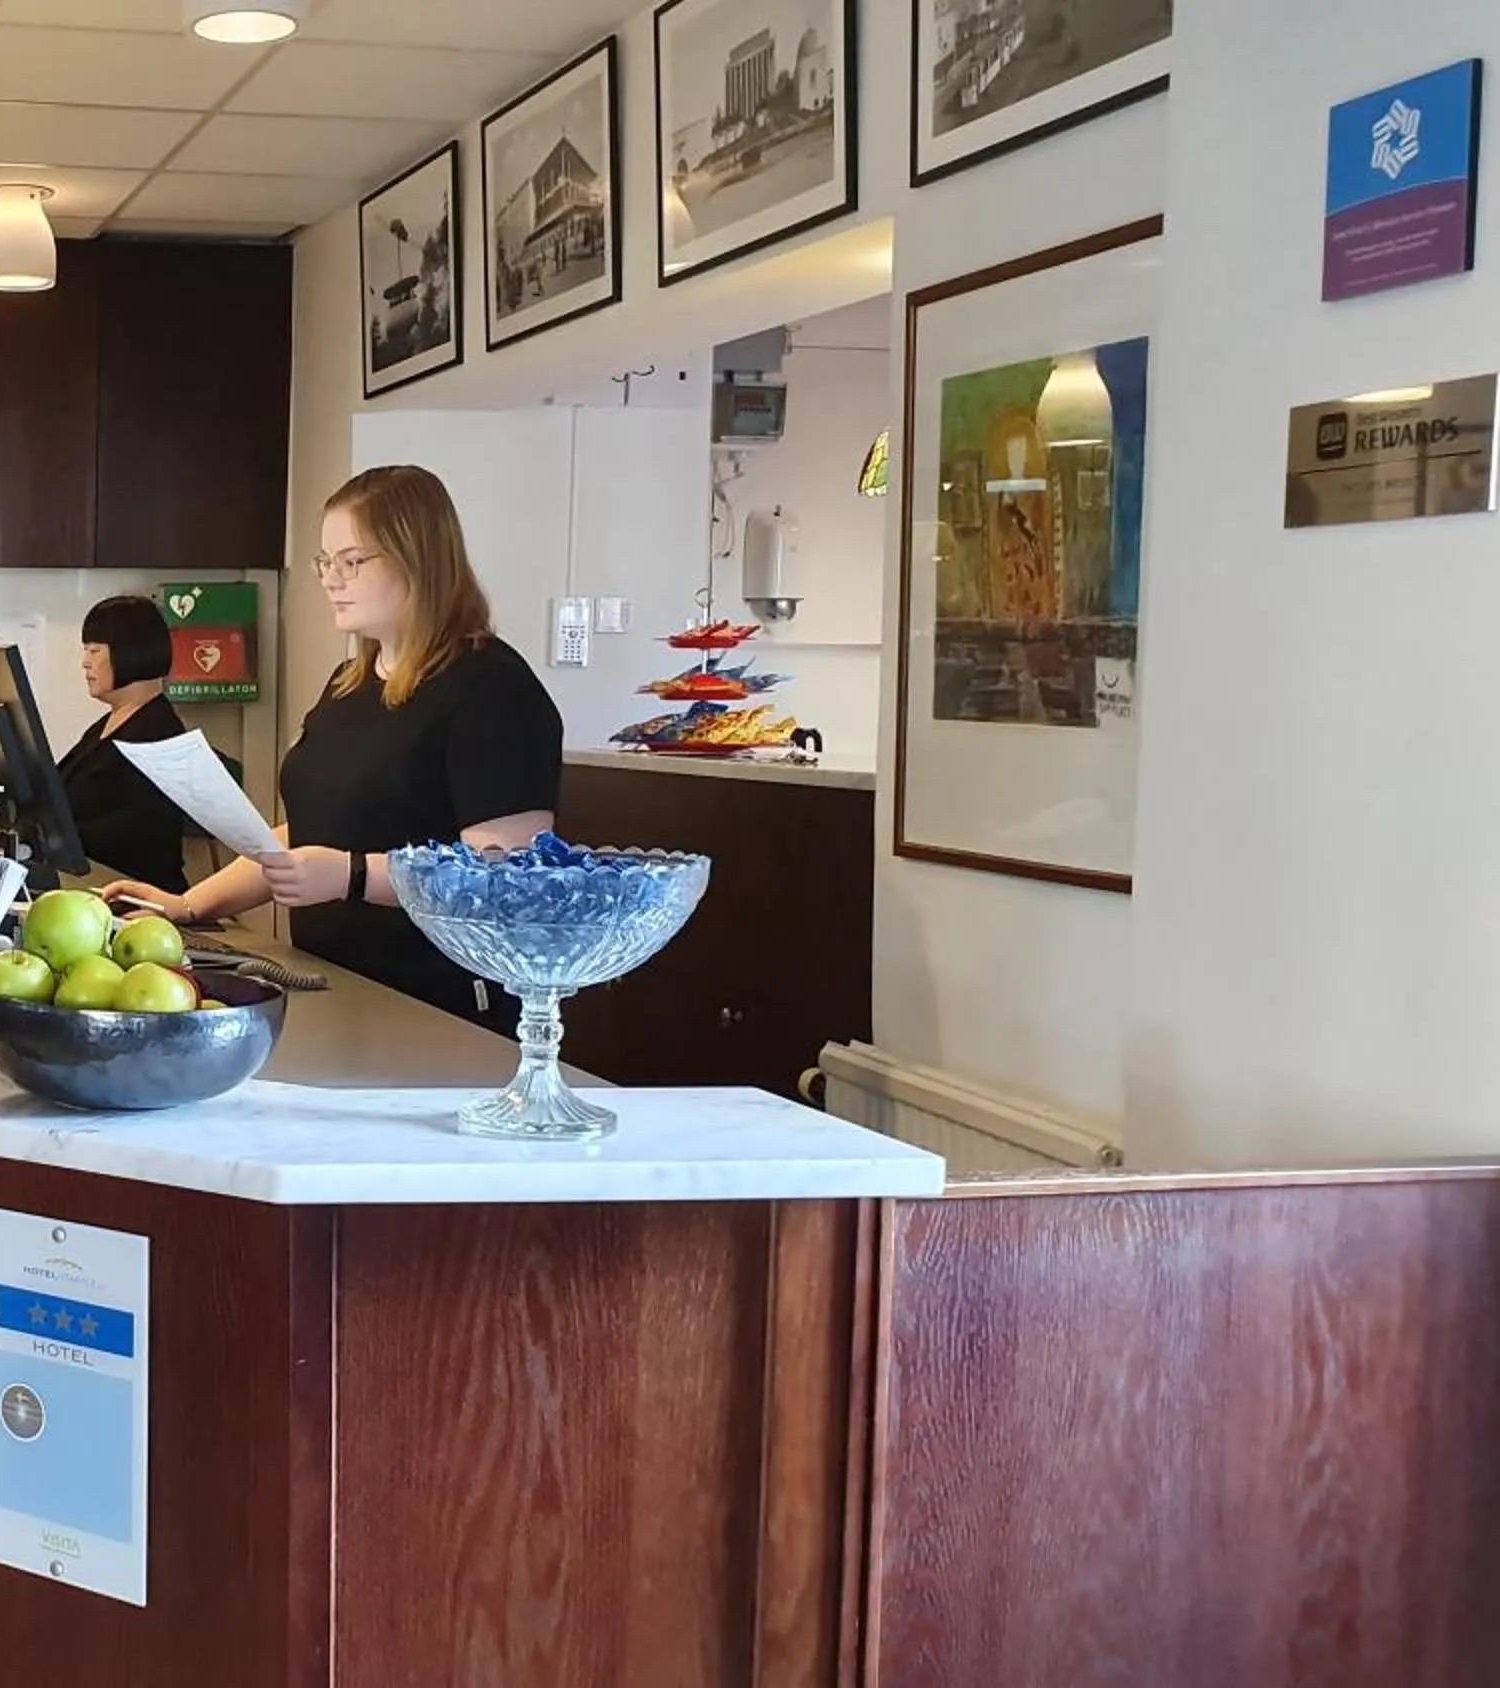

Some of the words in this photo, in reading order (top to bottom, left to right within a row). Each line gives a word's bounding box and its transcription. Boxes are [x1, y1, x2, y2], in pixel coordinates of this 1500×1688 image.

[1354, 415, 1459, 453] REWARDS
[33, 1340, 93, 1366] HOTEL
[41, 1526, 81, 1553] VISITA
